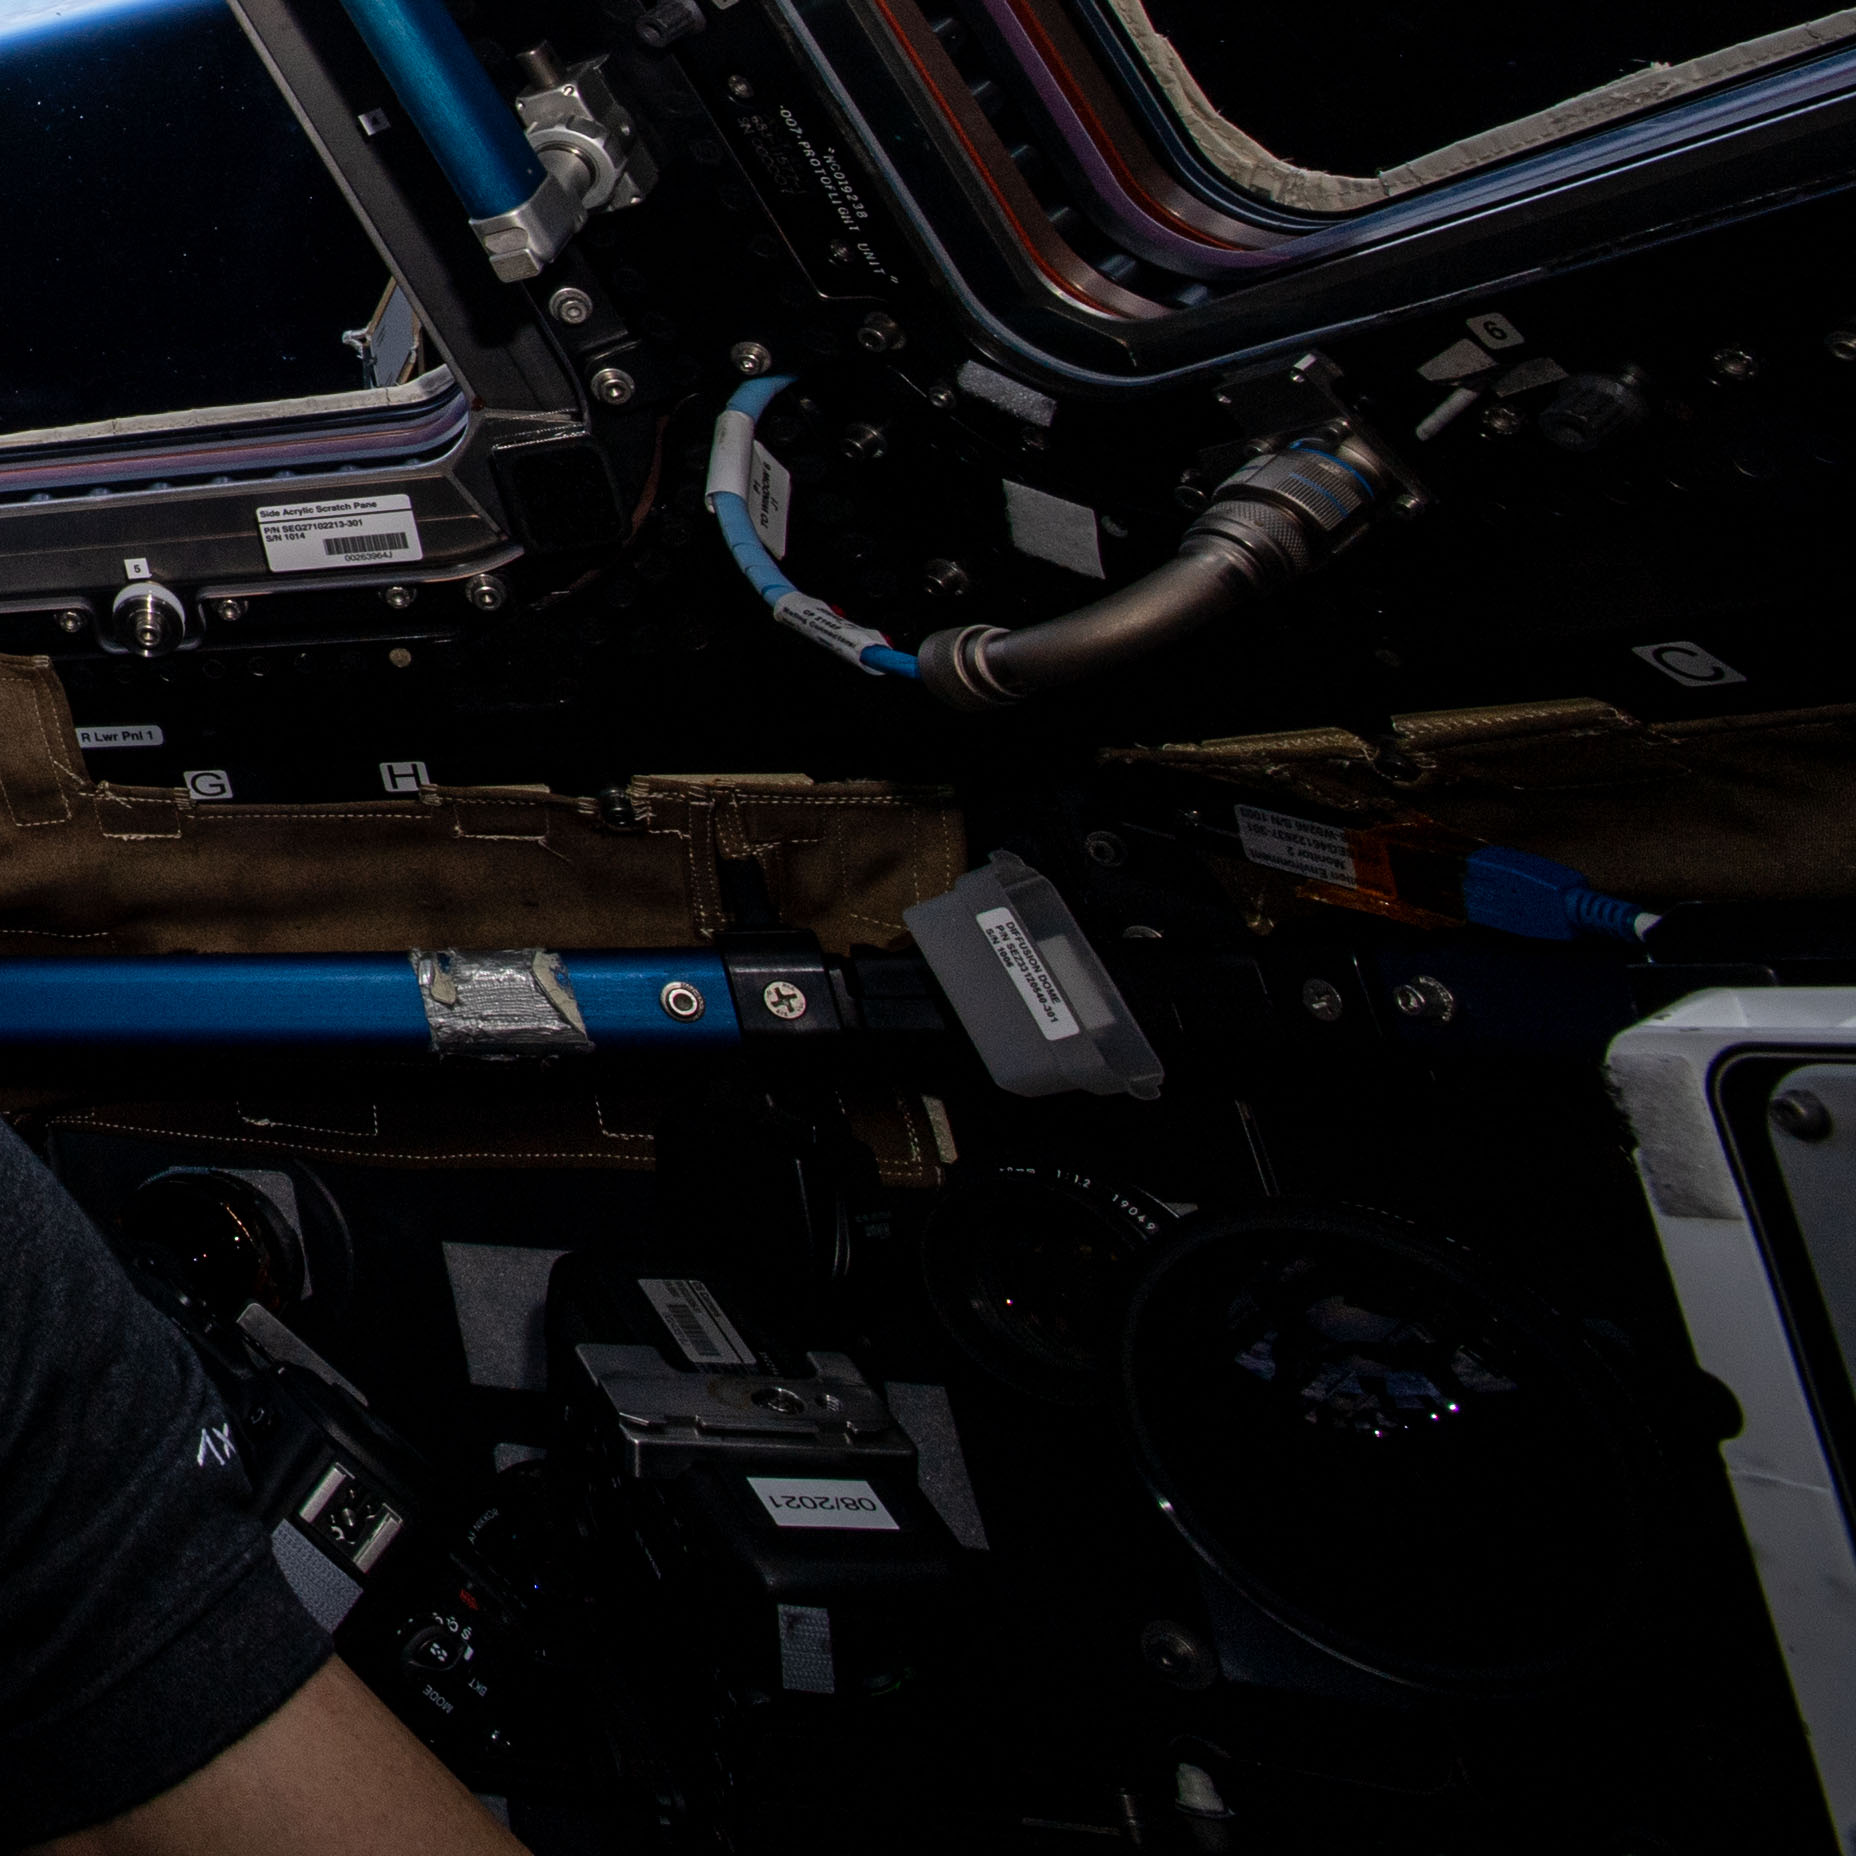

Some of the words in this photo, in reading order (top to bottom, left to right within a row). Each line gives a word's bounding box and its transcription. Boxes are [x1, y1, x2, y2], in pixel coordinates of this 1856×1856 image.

[762, 472, 772, 514] WINDOW
[260, 509, 280, 518] Side
[282, 507, 314, 518] Acrylic
[315, 503, 352, 514] Scratch
[353, 501, 378, 510] Pane
[264, 526, 280, 534] P/N
[266, 534, 282, 542] S/N
[81, 732, 90, 742] R
[94, 731, 120, 742] Lwr
[122, 730, 144, 742] Pnl
[191, 772, 226, 796] G
[388, 764, 418, 790] H
[986, 929, 1000, 944] S/N
[996, 925, 1010, 942] P/N
[1006, 921, 1042, 974] DIFFUSION
[1038, 974, 1062, 1004] DOME
[769, 1494, 878, 1512] 08/2021
[422, 1684, 454, 1716] MODE
